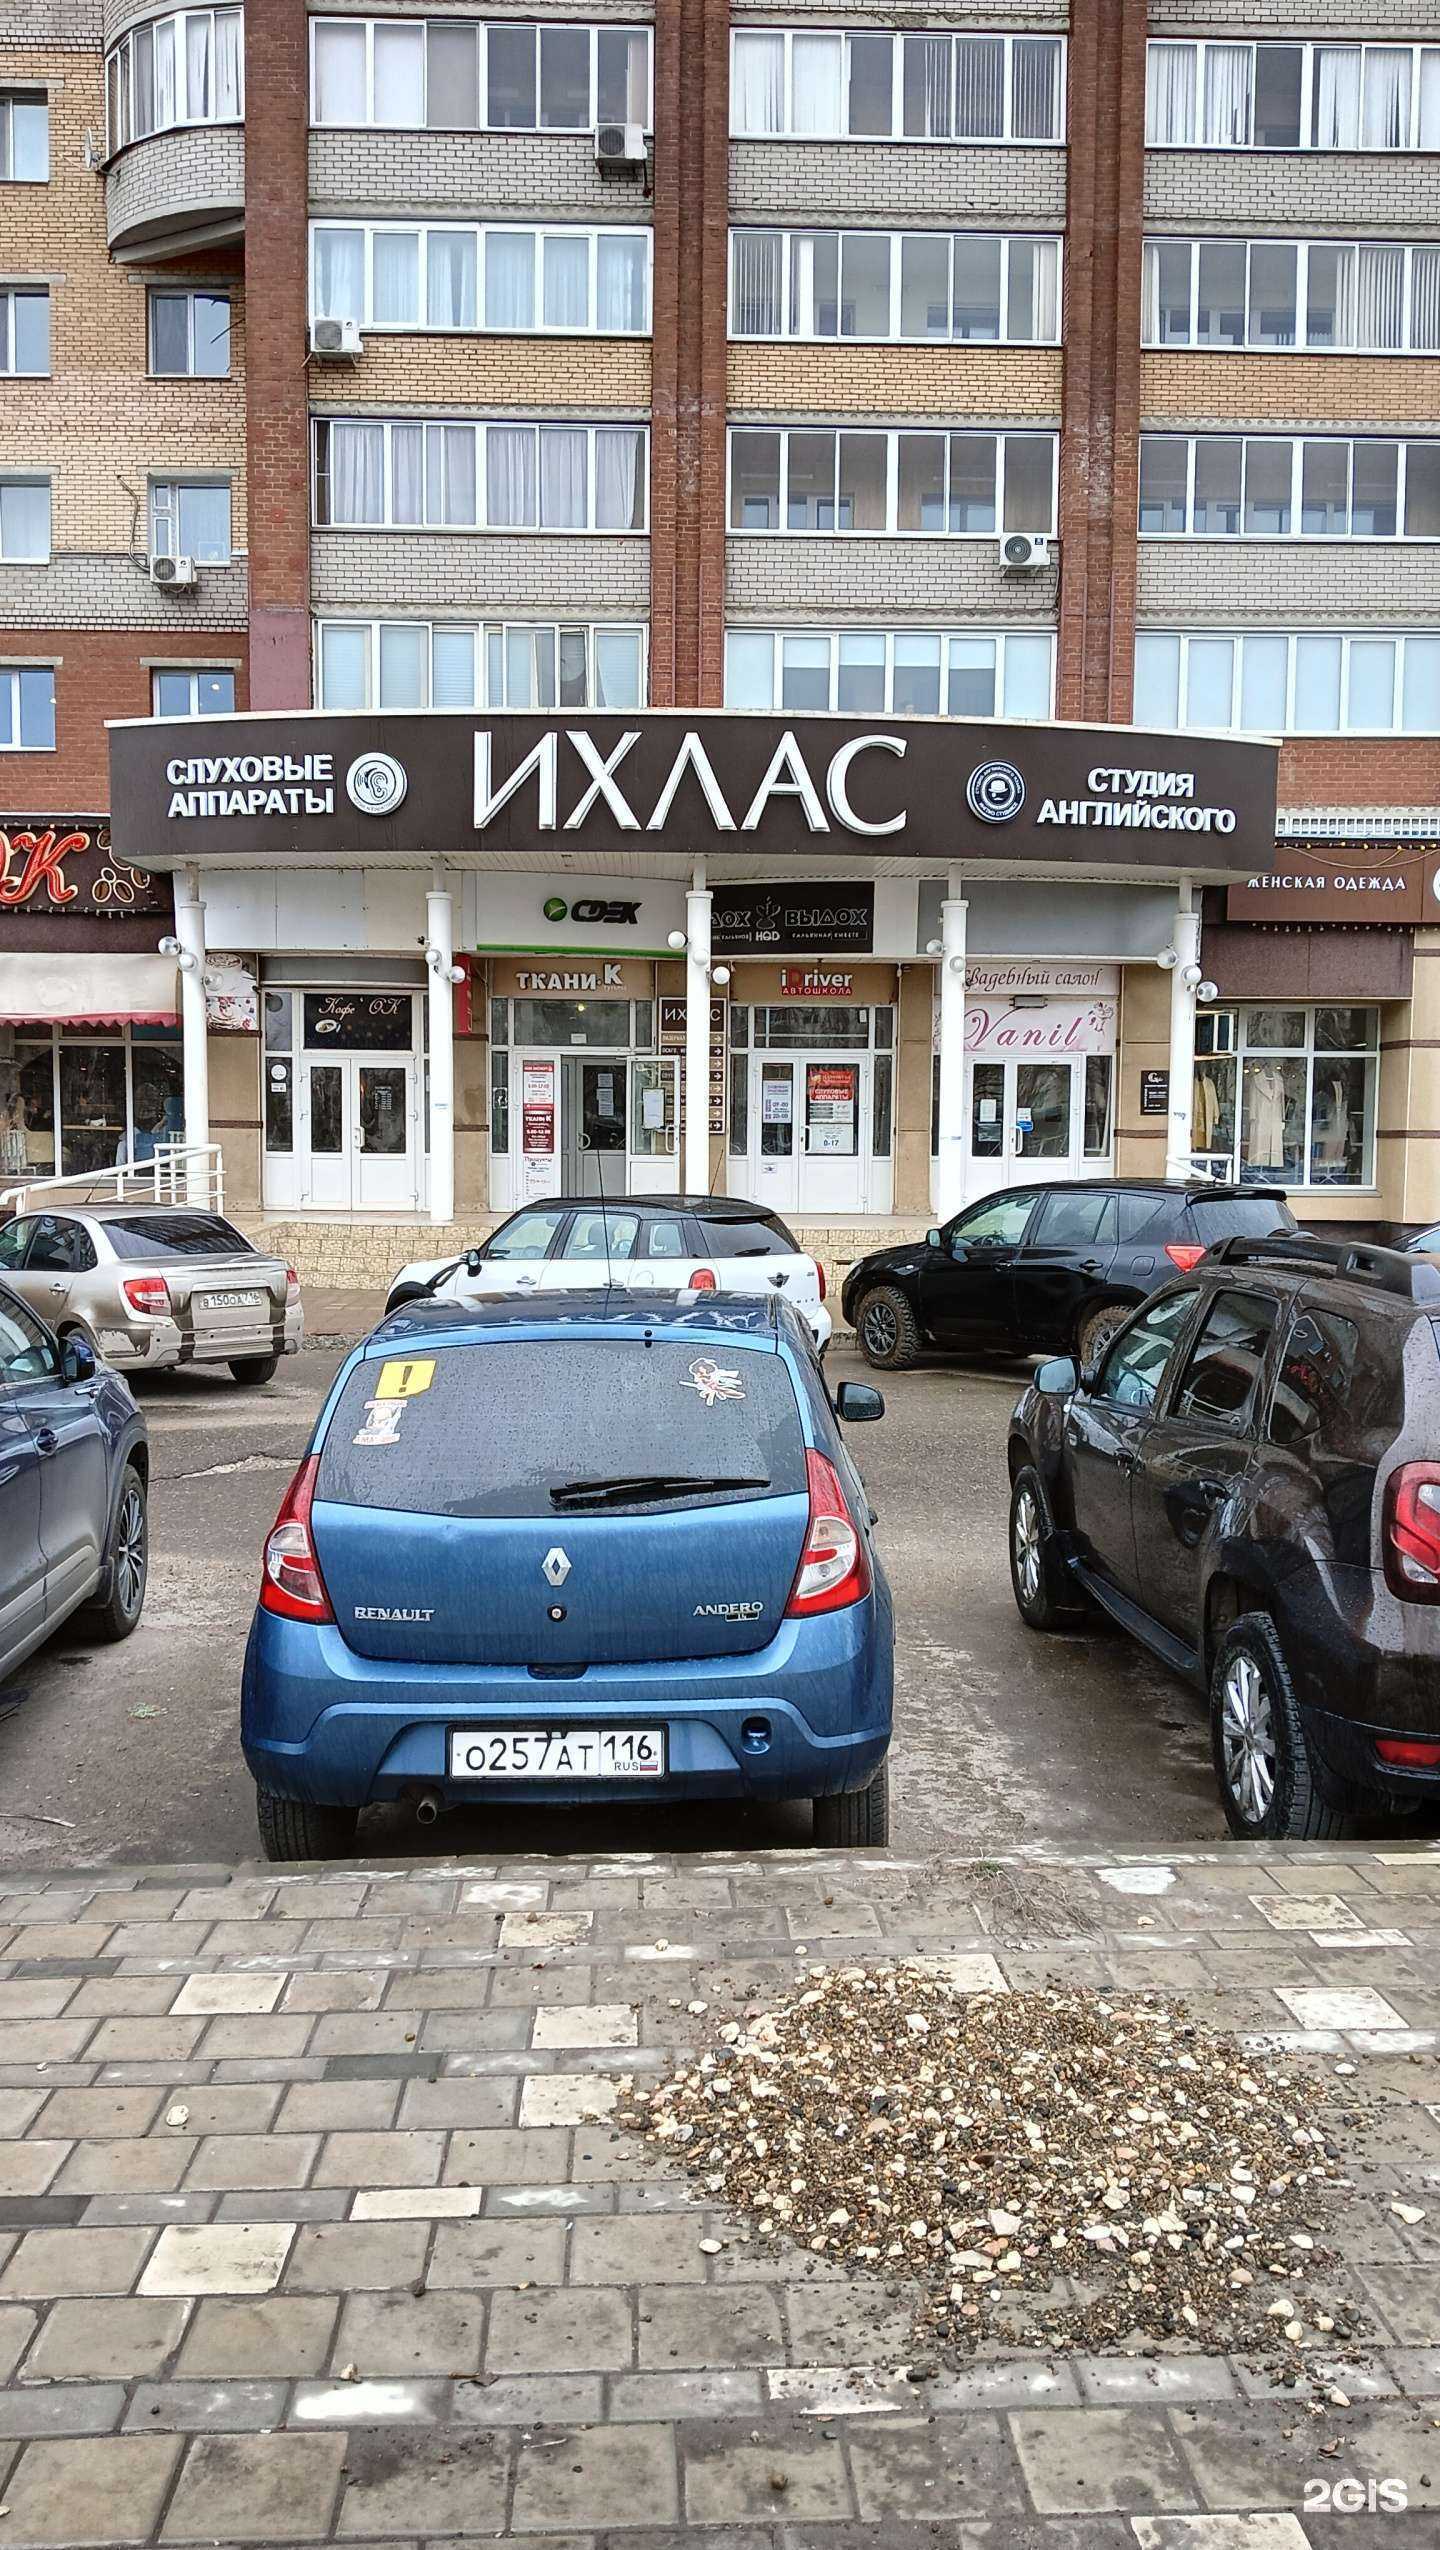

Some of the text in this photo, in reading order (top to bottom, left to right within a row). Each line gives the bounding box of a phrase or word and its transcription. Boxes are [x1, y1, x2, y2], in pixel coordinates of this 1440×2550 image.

[166, 754, 334, 786] СЛУХОВЫЕ
[473, 730, 908, 836] ИХЛАС
[1086, 767, 1195, 798] СТУДИЯ
[167, 788, 334, 818] АППАРАТЫ
[1036, 799, 1236, 834] АНГЛИЙСКОГО
[1333, 876, 1406, 891] ОДЕЖДА
[785, 907, 868, 927] ВЫДОХ
[781, 968, 853, 987] iDriver
[782, 987, 852, 995] АВТОШКОЛА
[318, 997, 406, 1020] Кофе ОК
[354, 1606, 434, 1621] RENAULT
[693, 1601, 763, 1616] ANDERO
[465, 1735, 651, 1771] О257АТ 116
[614, 1761, 639, 1771] RUS
